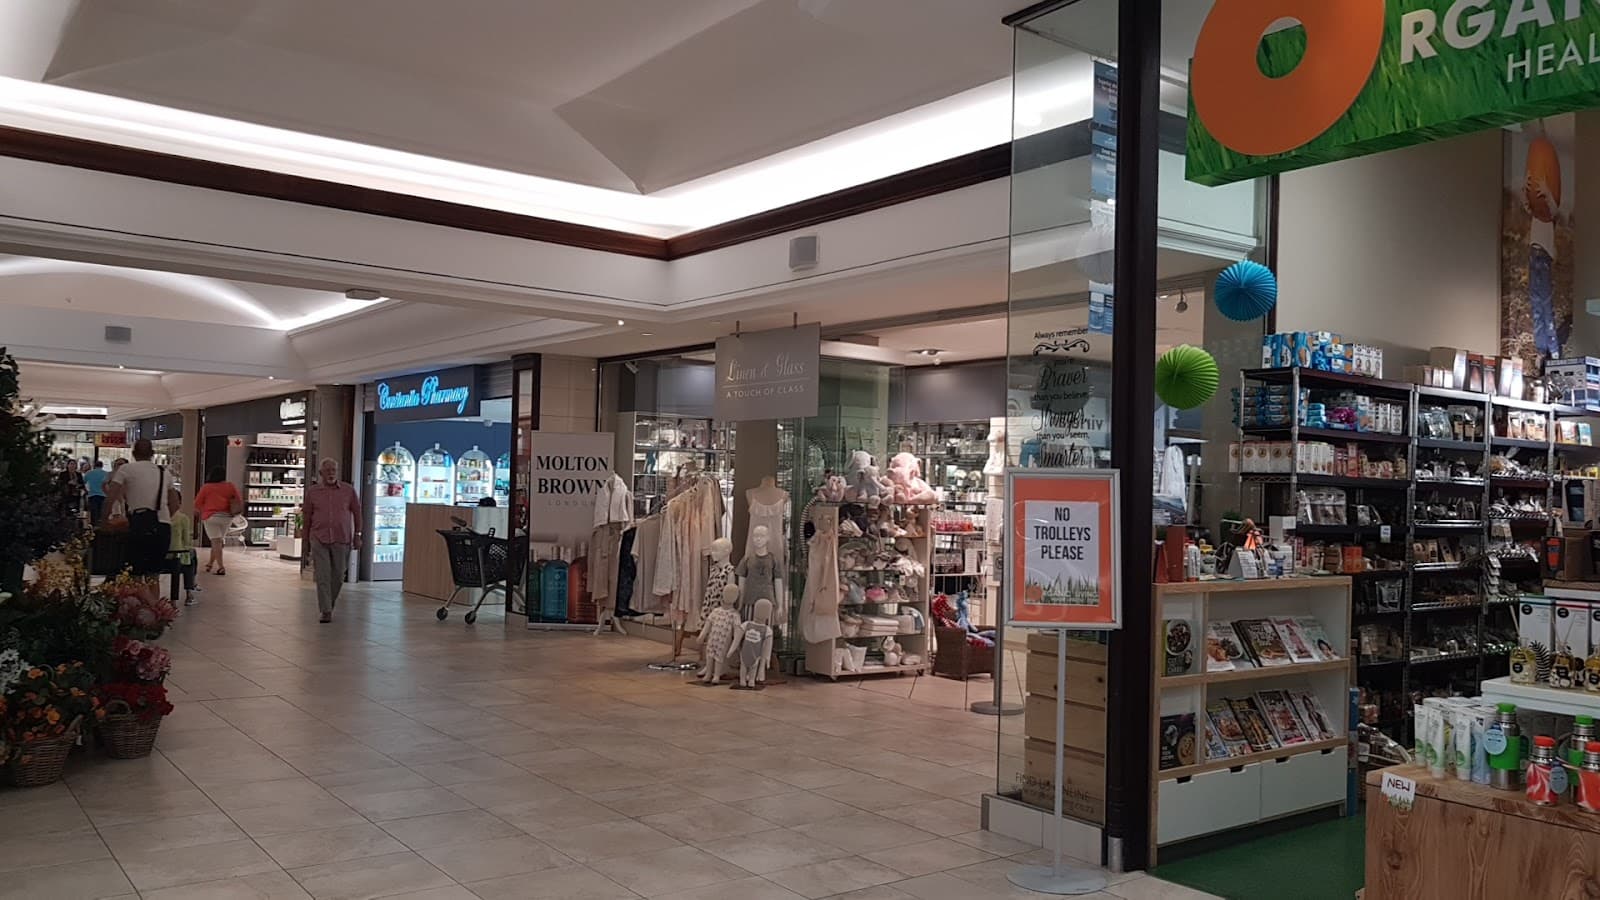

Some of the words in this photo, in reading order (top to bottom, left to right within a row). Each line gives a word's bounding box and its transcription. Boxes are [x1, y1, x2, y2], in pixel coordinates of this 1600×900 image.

[1034, 330, 1055, 340] Always
[1055, 327, 1088, 337] remember
[776, 352, 804, 377] Glass
[1040, 364, 1088, 391] Braver
[421, 376, 469, 414] Pharmacy
[734, 388, 761, 398] TOUCH
[764, 387, 774, 396] OF
[777, 384, 804, 394] CLASS
[1033, 391, 1048, 401] than
[1037, 432, 1051, 440] than
[1052, 433, 1065, 442] you
[536, 455, 609, 472] MOLTON
[1055, 507, 1070, 521] NO
[1033, 526, 1091, 541] TROLLEYS
[1040, 545, 1084, 560] PLEASE
[1387, 777, 1411, 791] NEW
